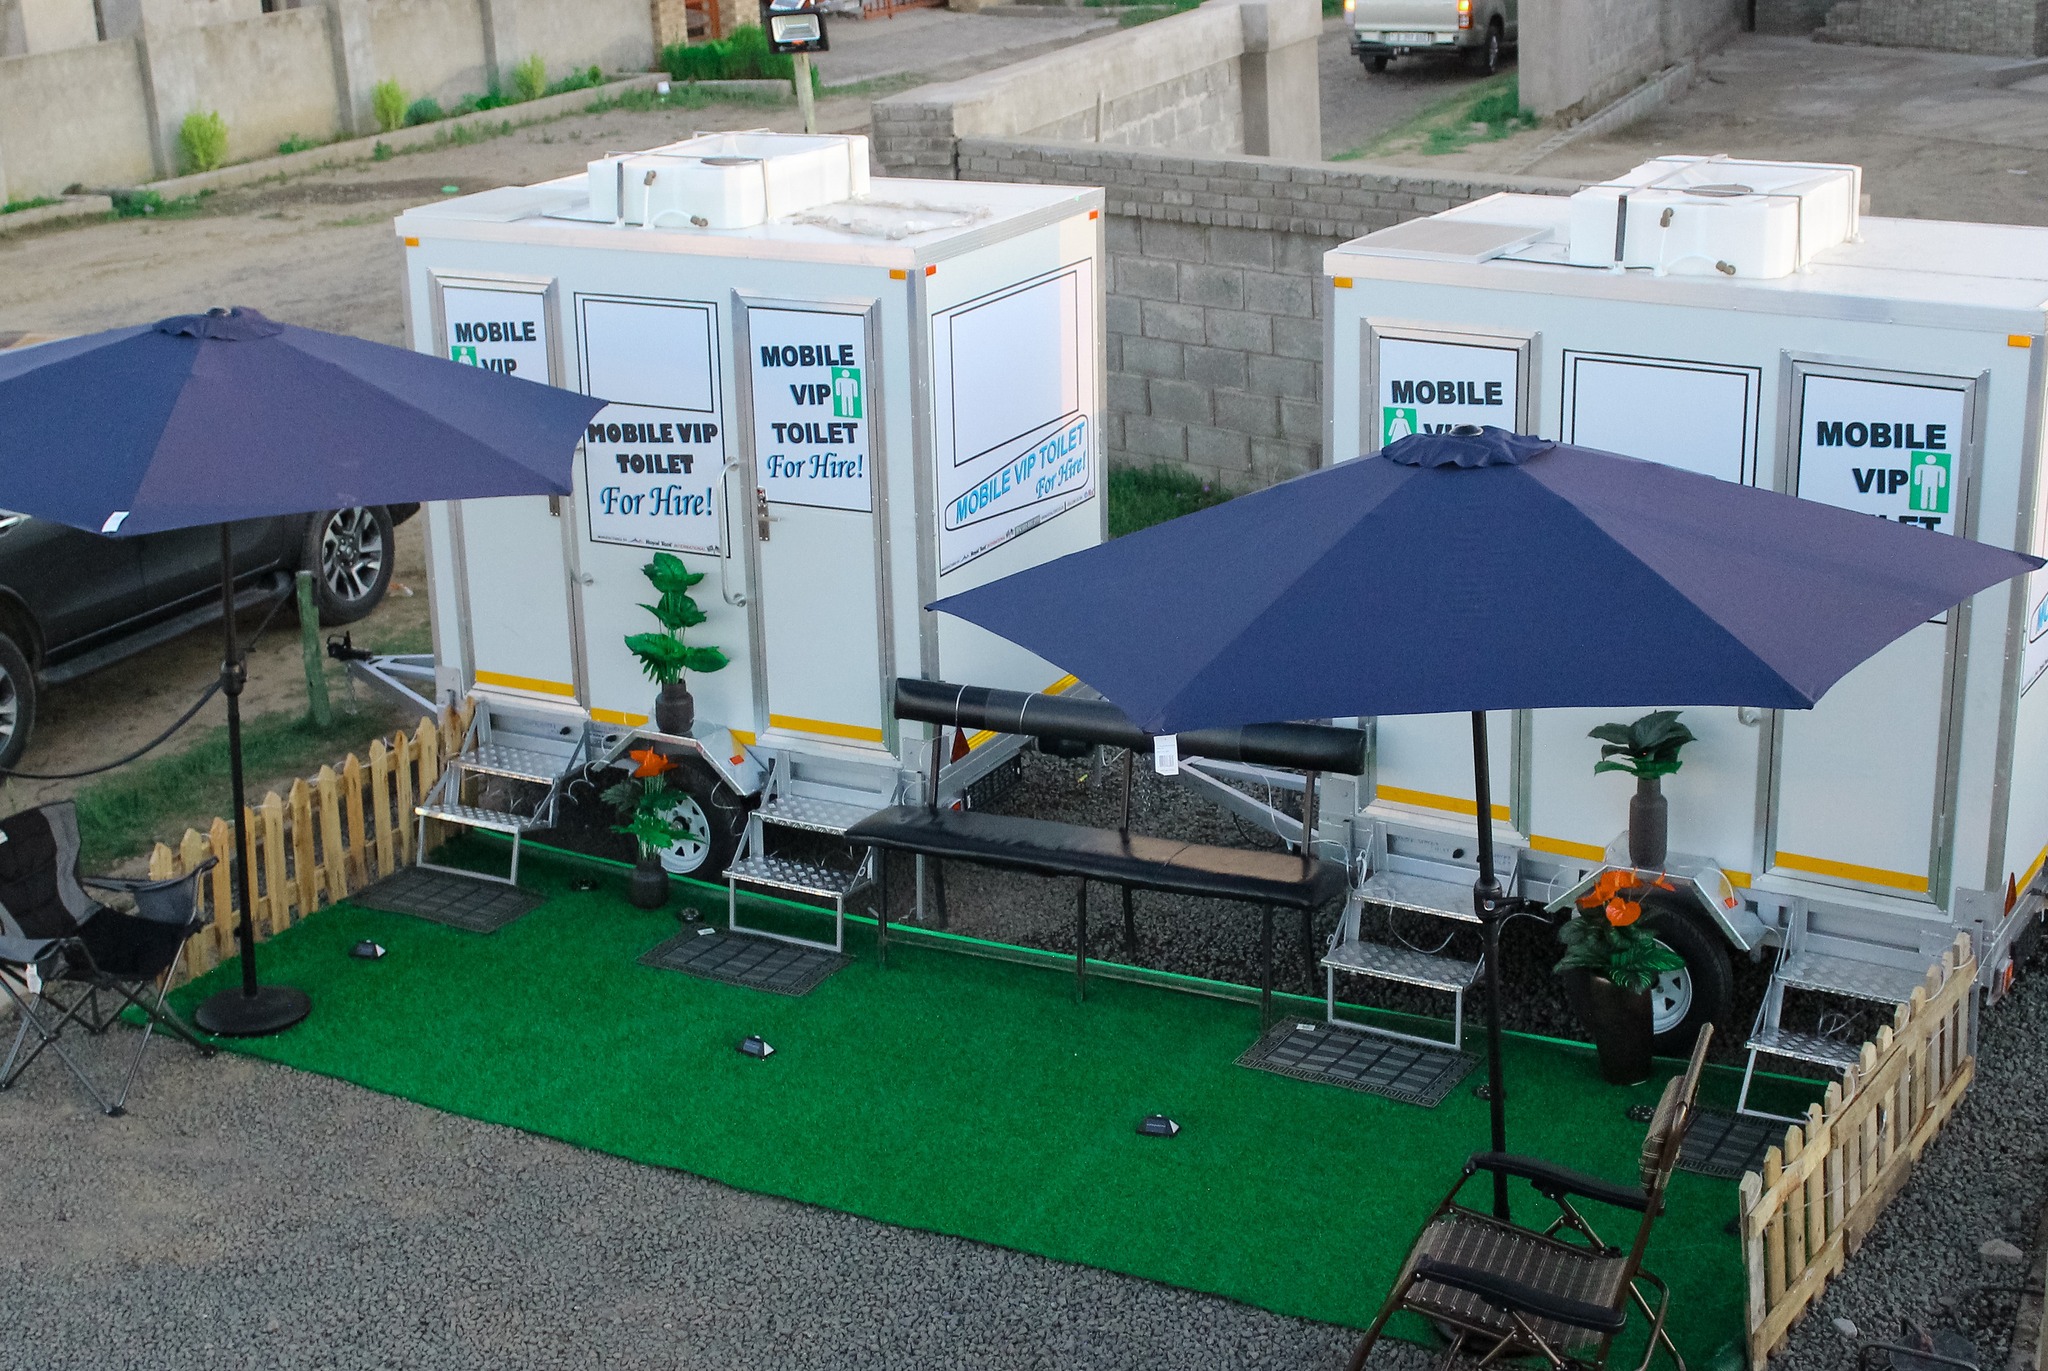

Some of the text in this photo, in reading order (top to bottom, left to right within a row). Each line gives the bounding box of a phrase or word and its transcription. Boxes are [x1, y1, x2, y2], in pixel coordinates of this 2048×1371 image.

[454, 321, 537, 342] MOBILE
[760, 344, 855, 367] MOBILE
[789, 383, 832, 406] VIP
[1391, 379, 1503, 405] MOBILE
[586, 422, 719, 444] MOBILE VIP
[771, 422, 859, 444] TOILET
[1816, 420, 1947, 450] MOBILE
[615, 453, 694, 474] TOILET
[766, 452, 864, 480] For Hire!
[955, 421, 1086, 525] MOBILE VIP TOILET
[1035, 448, 1088, 500] For Hire!
[1851, 467, 1909, 495] VIP
[600, 483, 713, 517] For Hire!
